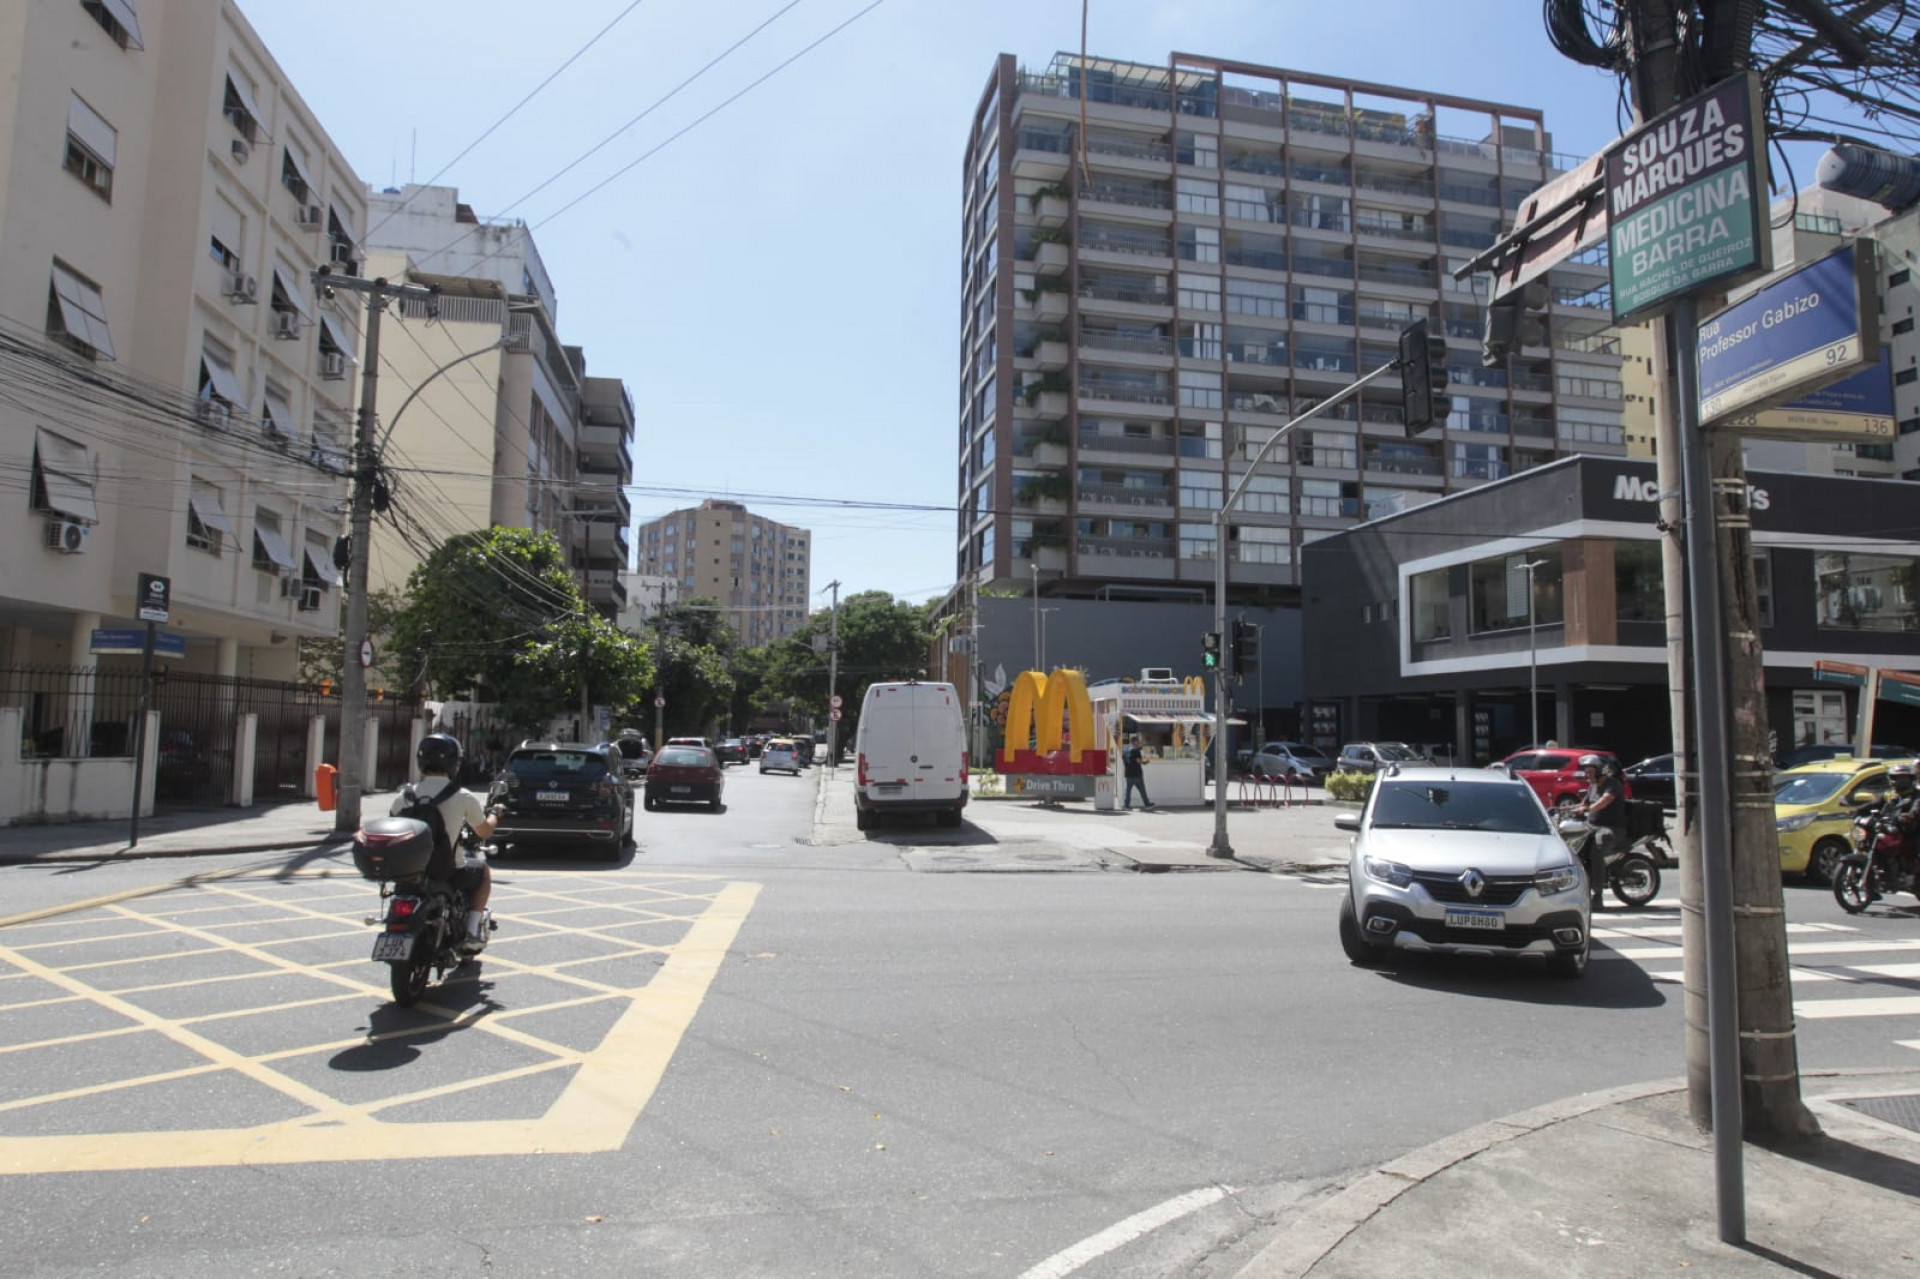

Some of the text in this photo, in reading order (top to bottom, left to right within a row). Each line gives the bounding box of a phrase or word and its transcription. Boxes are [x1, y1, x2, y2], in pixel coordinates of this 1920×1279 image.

[1623, 97, 1725, 176] SOUZA
[1613, 123, 1745, 216] MARQUES
[1615, 169, 1750, 257] MEDICINA
[1619, 238, 1752, 299] RUA RACHEL DE QUEIROZ
[1631, 215, 1729, 277] BARRA
[1633, 257, 1735, 303] BOSQUE DA BARRA
[1699, 321, 1721, 343] Rua
[1700, 292, 1820, 363] Professor Gabizo
[1825, 344, 1847, 366] 92
[1863, 417, 1889, 434] 136
[1026, 778, 1075, 792] Drive Thru
